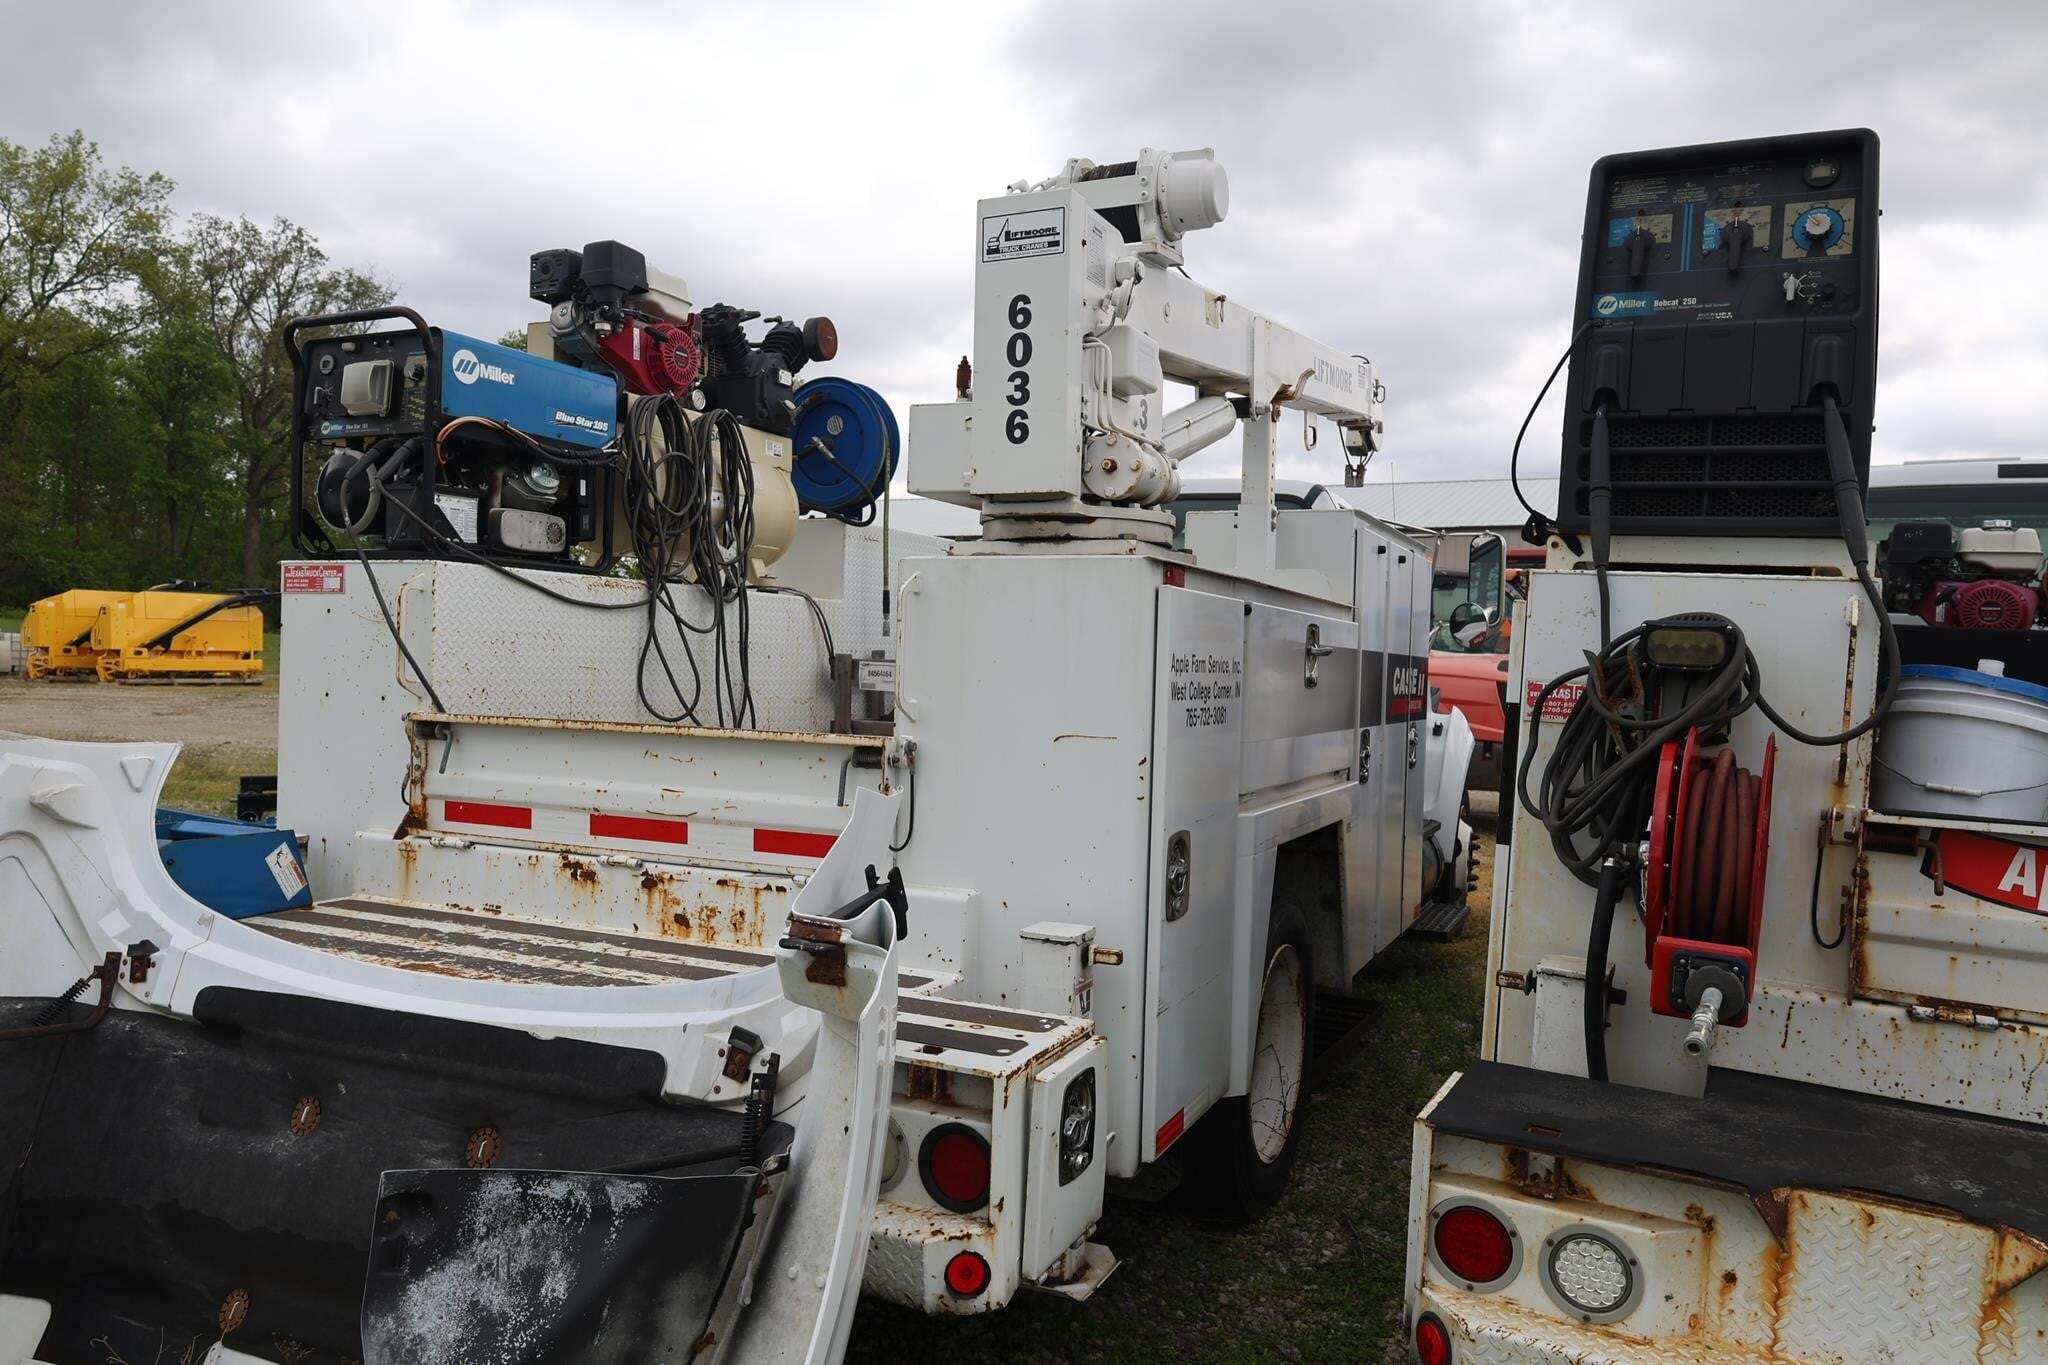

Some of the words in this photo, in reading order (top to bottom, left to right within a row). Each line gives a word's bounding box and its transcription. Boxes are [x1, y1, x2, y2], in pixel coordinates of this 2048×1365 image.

[1004, 226, 1058, 242] LIFTMOORE
[1000, 244, 1020, 254] TRUCK
[1022, 241, 1049, 251] CRANES
[1619, 300, 1647, 310] Miller
[1653, 298, 1679, 308] Bobcat
[1682, 297, 1697, 306] 250
[479, 363, 515, 385] Miller
[1005, 293, 1033, 445] 6036
[1313, 356, 1353, 394] LIFTMOORE
[555, 411, 575, 424] Blue
[575, 415, 594, 429] Star
[593, 420, 609, 432] 185
[1171, 652, 1189, 677] Apple
[1191, 654, 1206, 673] Farm
[1170, 681, 1187, 701] West
[1189, 681, 1211, 704] College
[1234, 681, 1241, 698] IN
[1393, 667, 1417, 696] CASE
